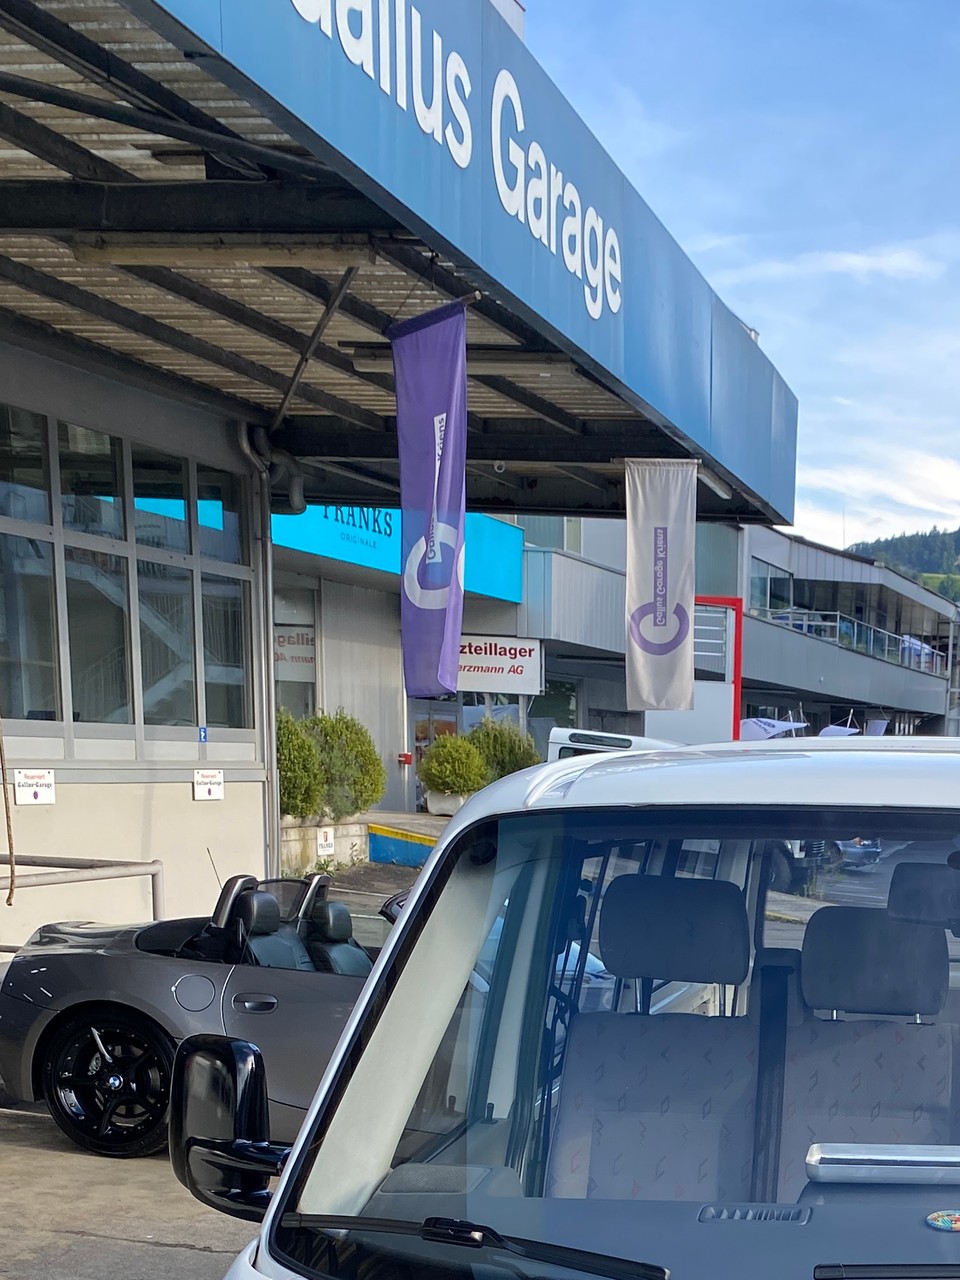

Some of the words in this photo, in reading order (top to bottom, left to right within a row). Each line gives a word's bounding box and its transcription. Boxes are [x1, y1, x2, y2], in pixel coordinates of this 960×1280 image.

[290, 0, 472, 168] allus
[491, 69, 622, 320] Garage
[340, 532, 377, 549] ORIGINALE
[459, 642, 535, 660] zteillager
[458, 664, 504, 674] erzmann
[507, 664, 524, 675] AG
